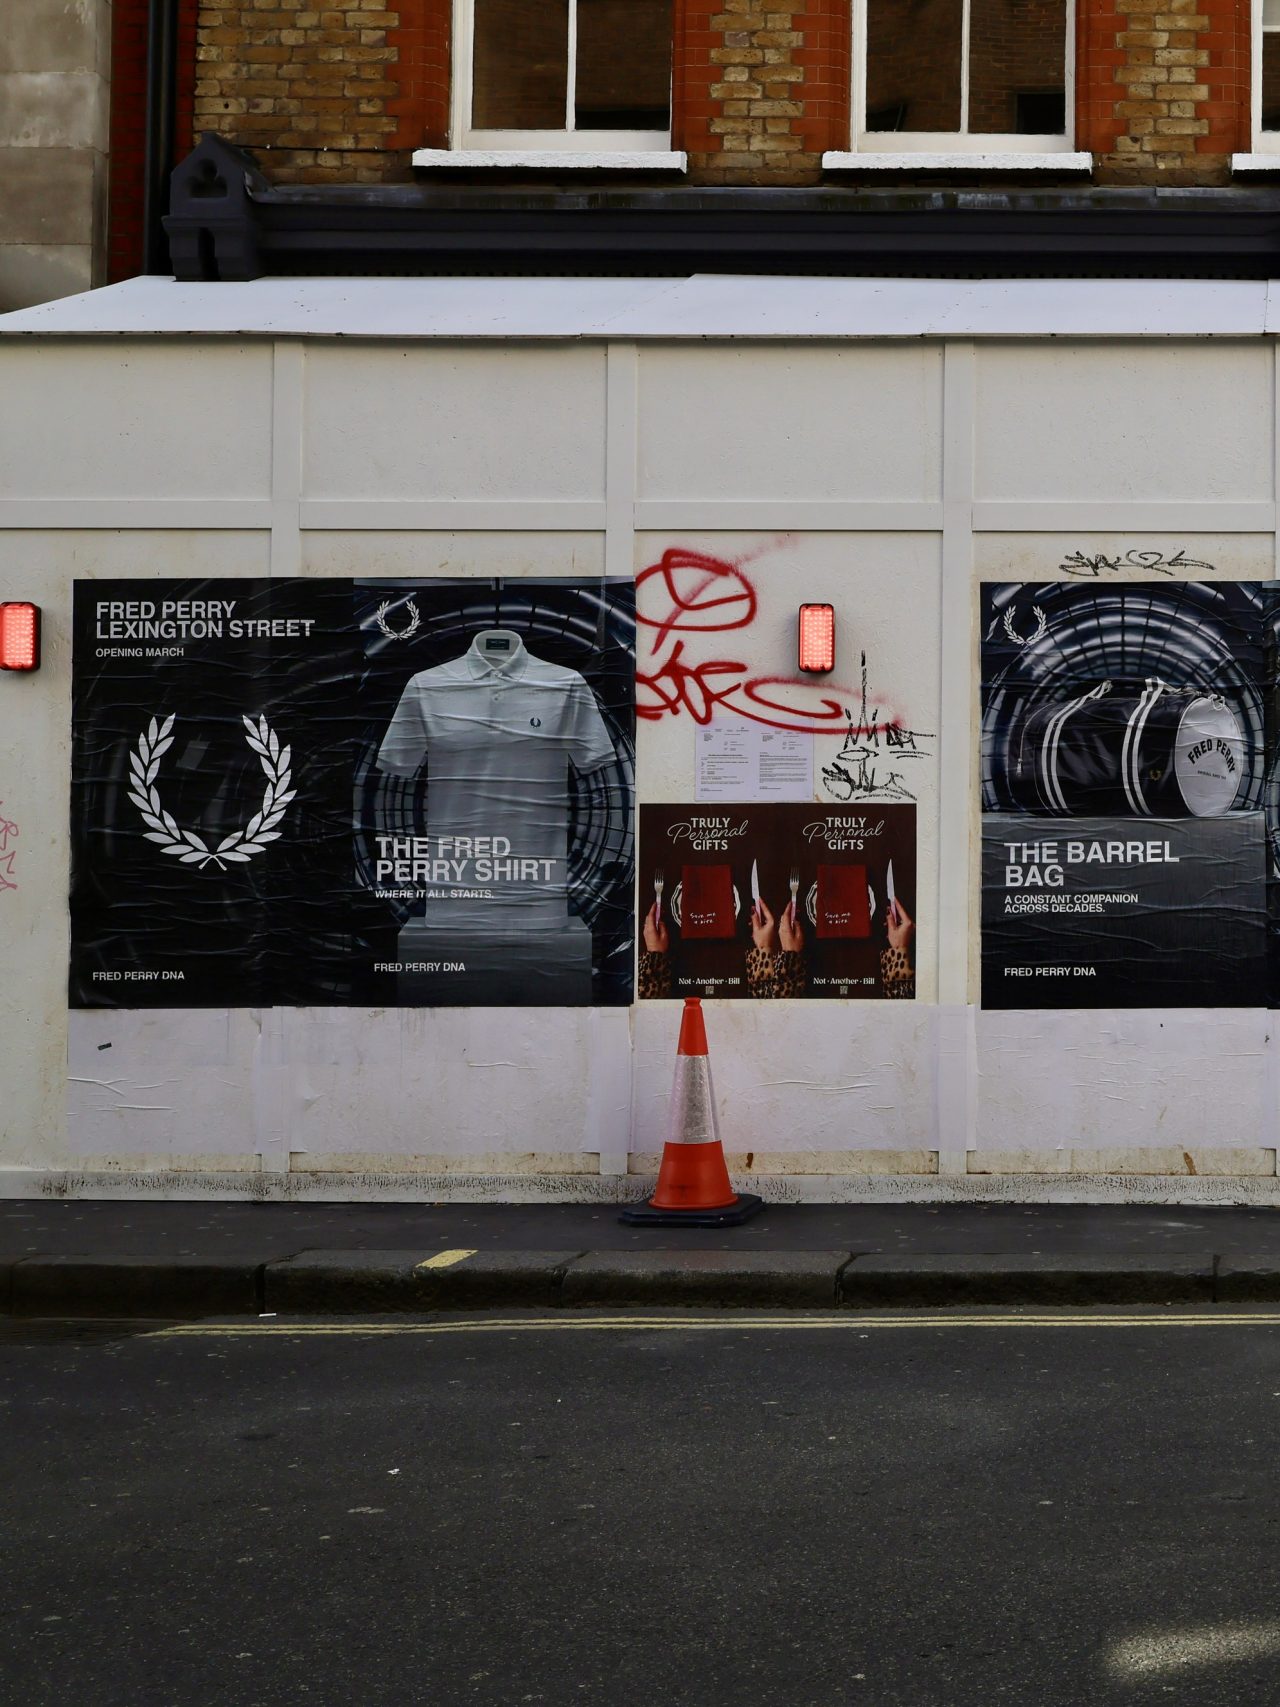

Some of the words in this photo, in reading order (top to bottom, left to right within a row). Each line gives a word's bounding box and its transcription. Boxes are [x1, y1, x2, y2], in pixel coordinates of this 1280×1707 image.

[96, 601, 156, 620] FRED
[161, 600, 237, 619] PERRY
[96, 620, 222, 639] LEXINGTON
[228, 619, 316, 638] STREET
[95, 648, 143, 658] OPENING
[146, 648, 184, 657] MARCH
[1188, 738, 1212, 764] FRED
[1216, 739, 1236, 773] PERRY
[690, 817, 730, 828] TRULY
[825, 817, 866, 828] TRULY
[666, 819, 749, 844] Personal
[375, 836, 430, 858] THE
[438, 836, 511, 858] FRED
[692, 839, 728, 850] GIFTS
[827, 839, 864, 850] GIFTS
[1004, 842, 1058, 864] THE
[1066, 840, 1180, 864] BARREL
[376, 860, 468, 882] PERRY
[474, 859, 556, 882] SHIRT
[1005, 864, 1064, 887] BAG
[375, 889, 414, 899] WHERE
[416, 889, 426, 899] IT
[427, 889, 448, 899] ALL
[450, 889, 494, 899] STARTS.
[1004, 895, 1012, 904] A
[1014, 894, 1072, 904] CONSTANT
[1073, 894, 1138, 903] COMPANION
[1004, 904, 1049, 914] ACROSS
[1051, 903, 1106, 913] DECADES.
[374, 962, 402, 972] FRED
[405, 962, 441, 972] PERRY
[442, 962, 466, 972] DNA
[1004, 967, 1033, 977] FRED
[1035, 967, 1071, 977] PERRY
[1073, 967, 1096, 977] DNA
[92, 972, 122, 981] FRED
[124, 971, 160, 981] PERRY
[161, 971, 185, 980] DNA
[678, 977, 692, 985] Not
[695, 977, 724, 985] Another
[728, 977, 740, 985] Bill
[813, 977, 826, 985] Not
[830, 977, 859, 985] Another
[863, 977, 875, 985] Bill
